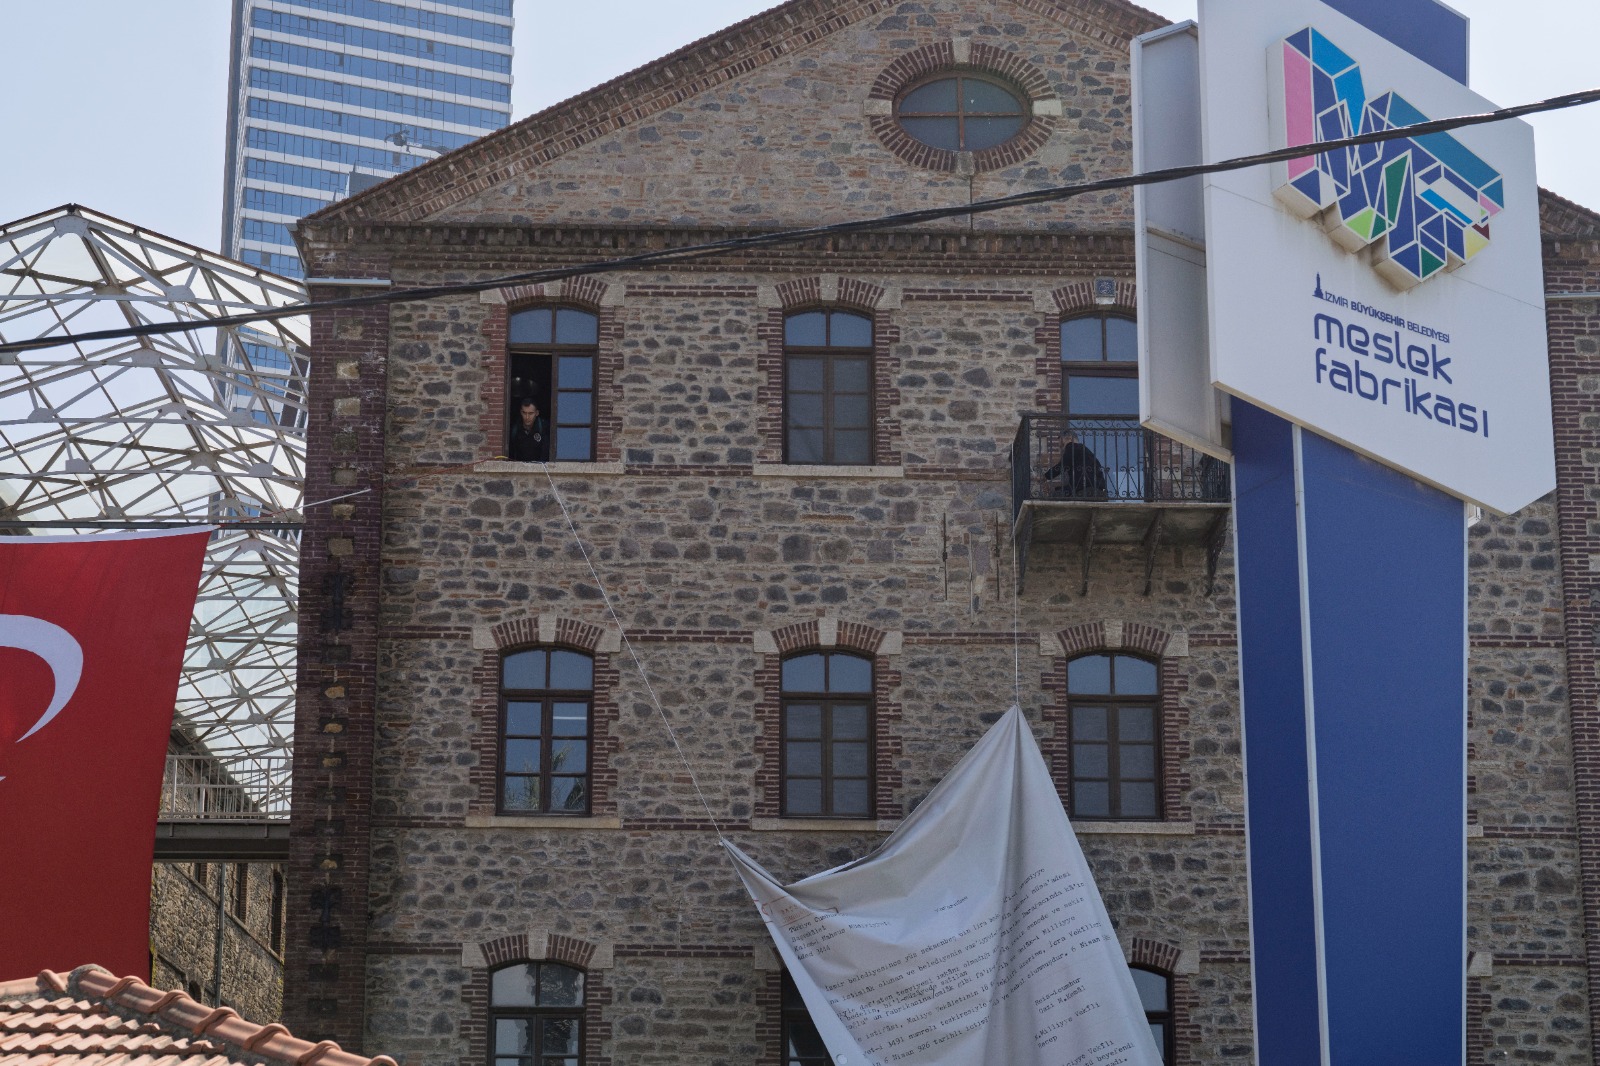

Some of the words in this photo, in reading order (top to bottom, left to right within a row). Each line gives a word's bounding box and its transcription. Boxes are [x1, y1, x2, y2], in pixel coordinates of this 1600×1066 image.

[1314, 313, 1453, 384] meslek
[1325, 291, 1348, 308] İZMİR
[1350, 301, 1405, 328] BÜYÜKŞEHİR
[1407, 320, 1450, 343] BELEDİYESİ
[1315, 347, 1489, 438] fabrikası
